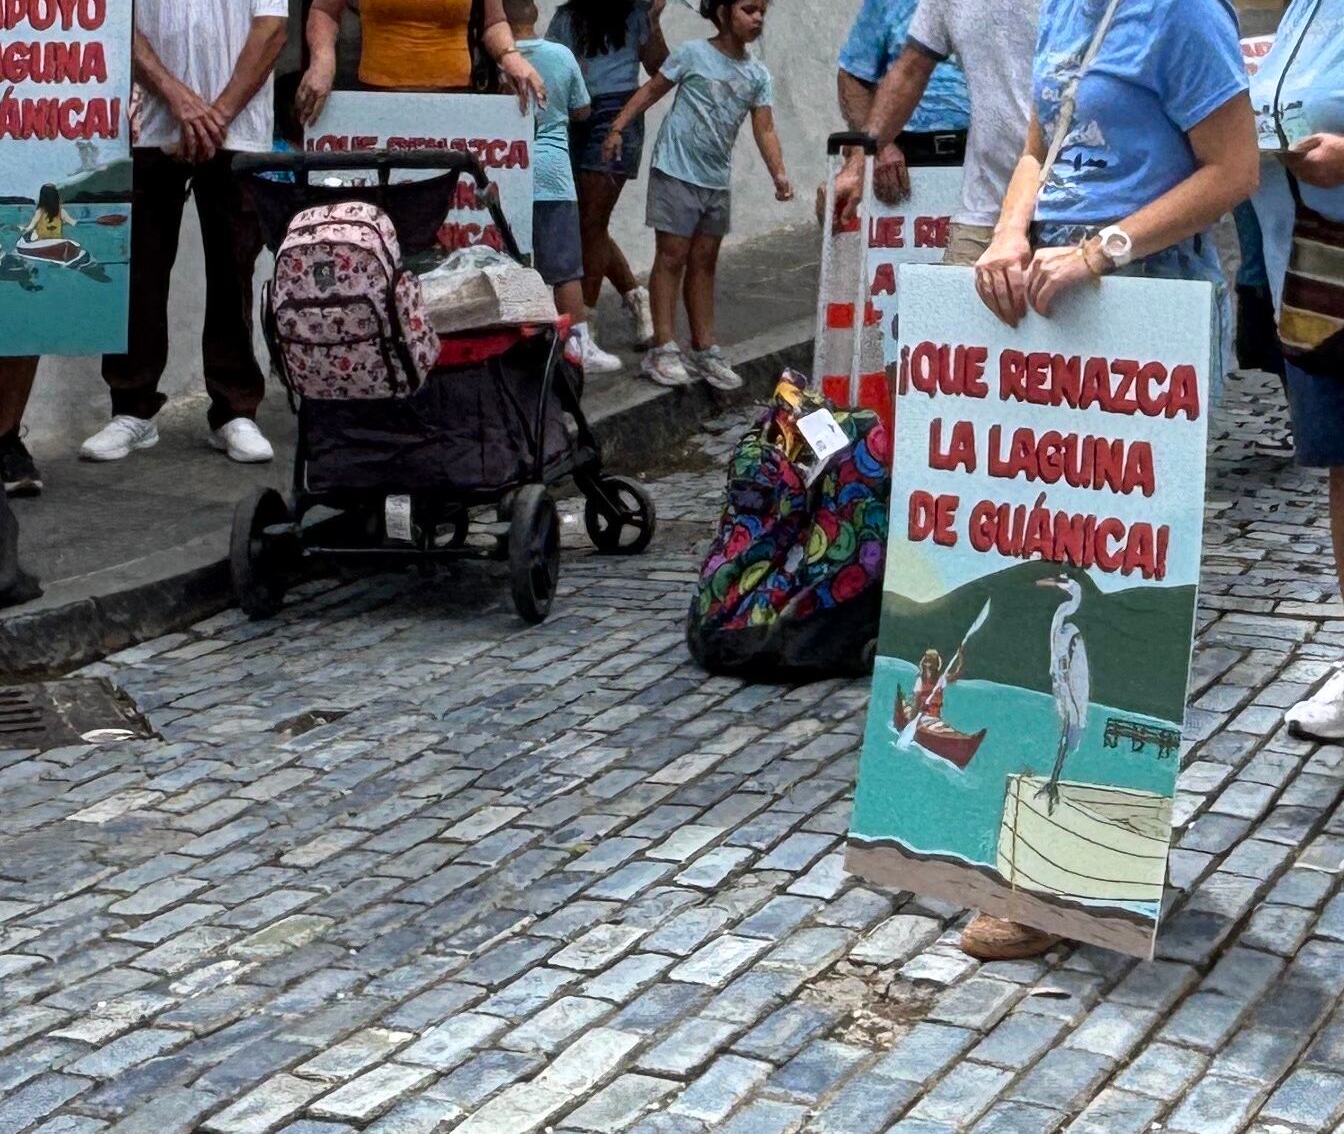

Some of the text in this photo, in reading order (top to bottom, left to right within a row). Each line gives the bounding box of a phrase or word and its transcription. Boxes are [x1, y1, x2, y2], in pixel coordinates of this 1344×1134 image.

[898, 341, 1200, 421] ¡QUE RENAZCA
[928, 417, 1155, 498] LA LAGUNA
[908, 490, 1170, 581] DE GUÁNICA!
